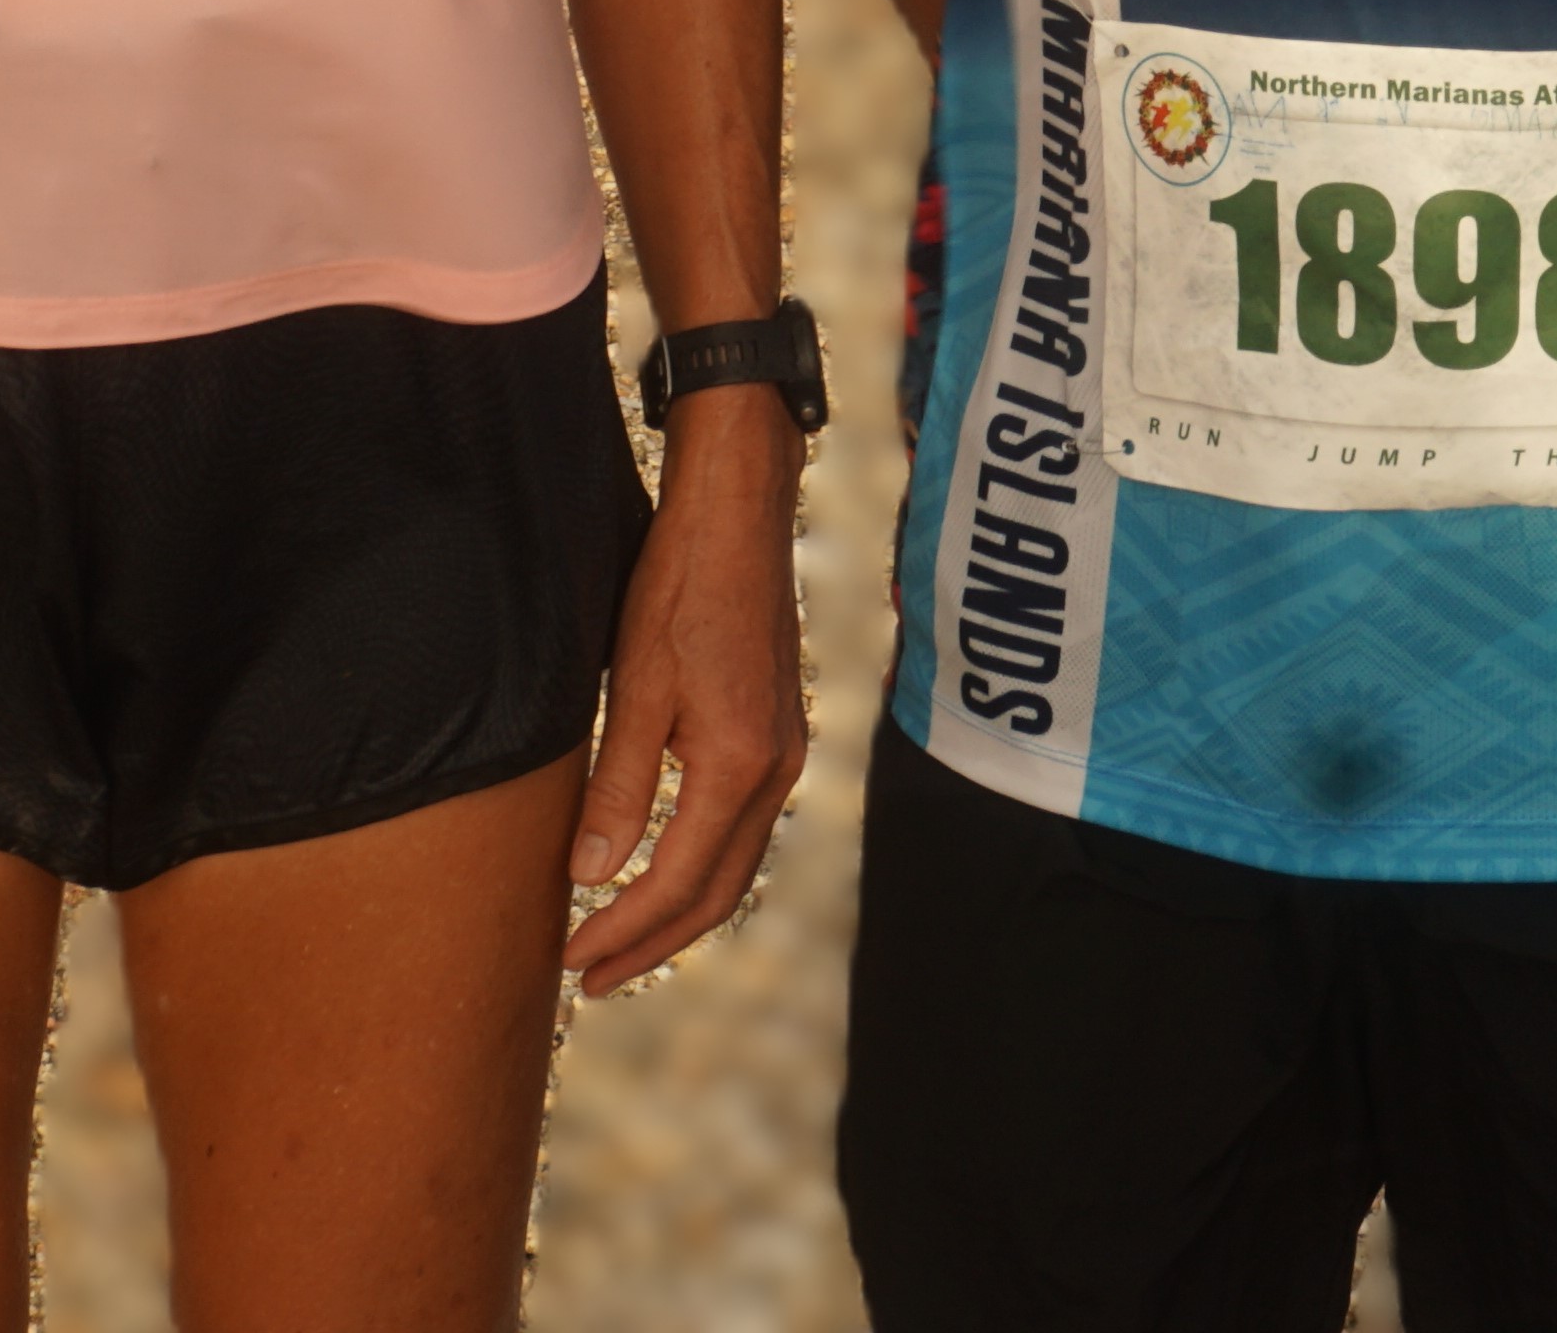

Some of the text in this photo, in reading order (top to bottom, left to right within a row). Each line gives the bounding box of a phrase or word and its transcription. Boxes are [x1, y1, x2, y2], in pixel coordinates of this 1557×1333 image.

[1249, 69, 1377, 99] Northern
[1386, 78, 1525, 107] Marianas
[958, 381, 1085, 736] ISLANDS
